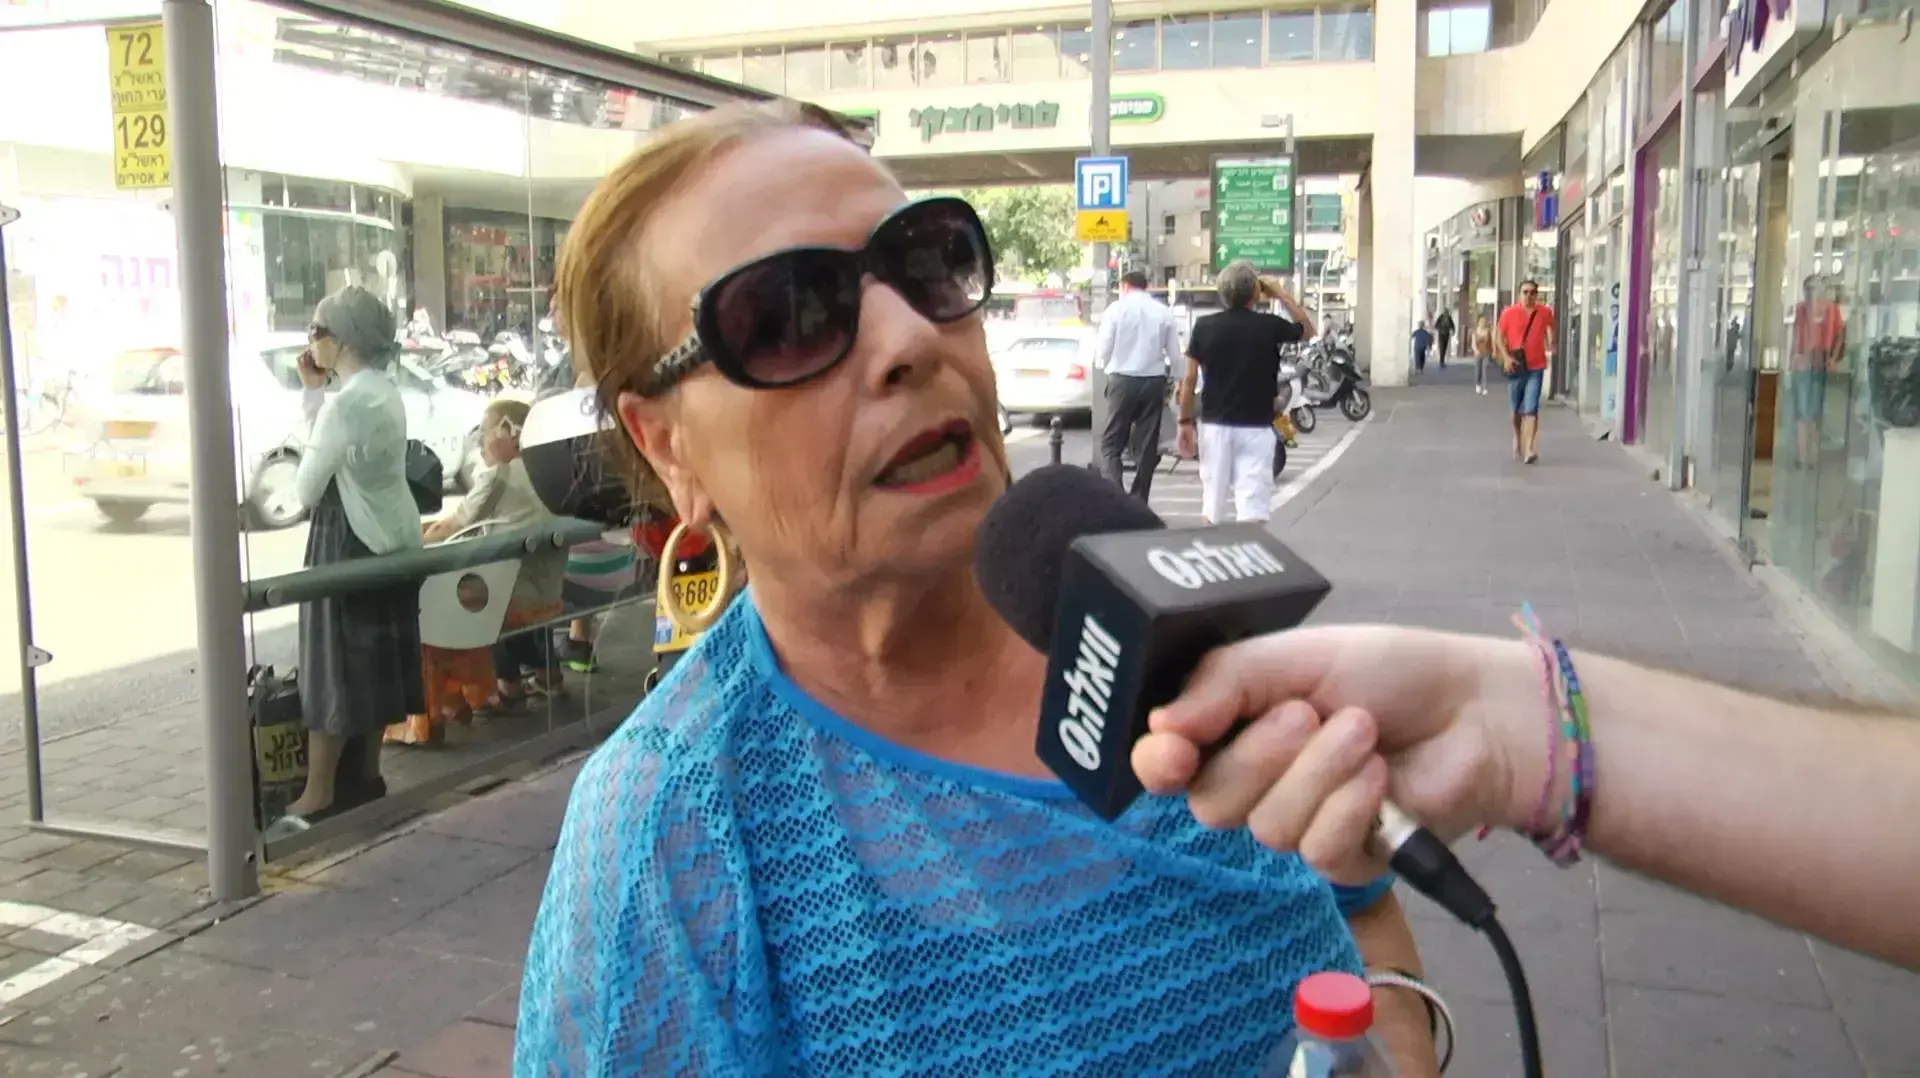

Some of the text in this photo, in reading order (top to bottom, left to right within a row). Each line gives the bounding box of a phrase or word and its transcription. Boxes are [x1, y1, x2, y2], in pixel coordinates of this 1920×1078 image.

[119, 32, 153, 67] 72
[117, 113, 166, 149] 129
[908, 100, 1060, 144] סטימצקי
